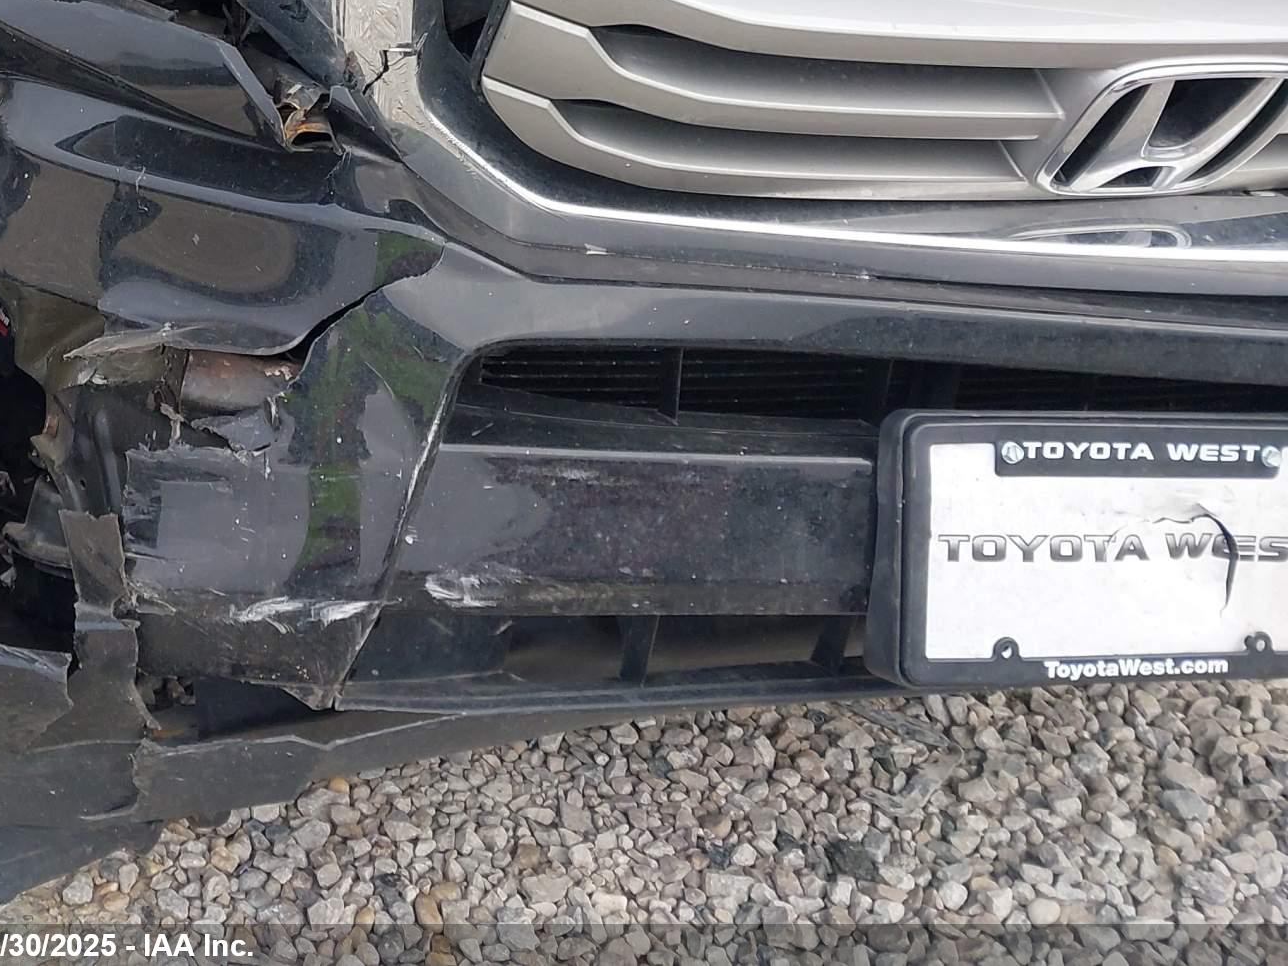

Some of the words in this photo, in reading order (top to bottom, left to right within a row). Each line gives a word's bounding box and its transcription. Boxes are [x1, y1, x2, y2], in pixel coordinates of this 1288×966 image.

[1023, 441, 1155, 460] TOYOTA
[1166, 443, 1261, 462] WEST
[938, 533, 1150, 562] TOYOTA
[1044, 658, 1229, 681] ToyotaWest.com
